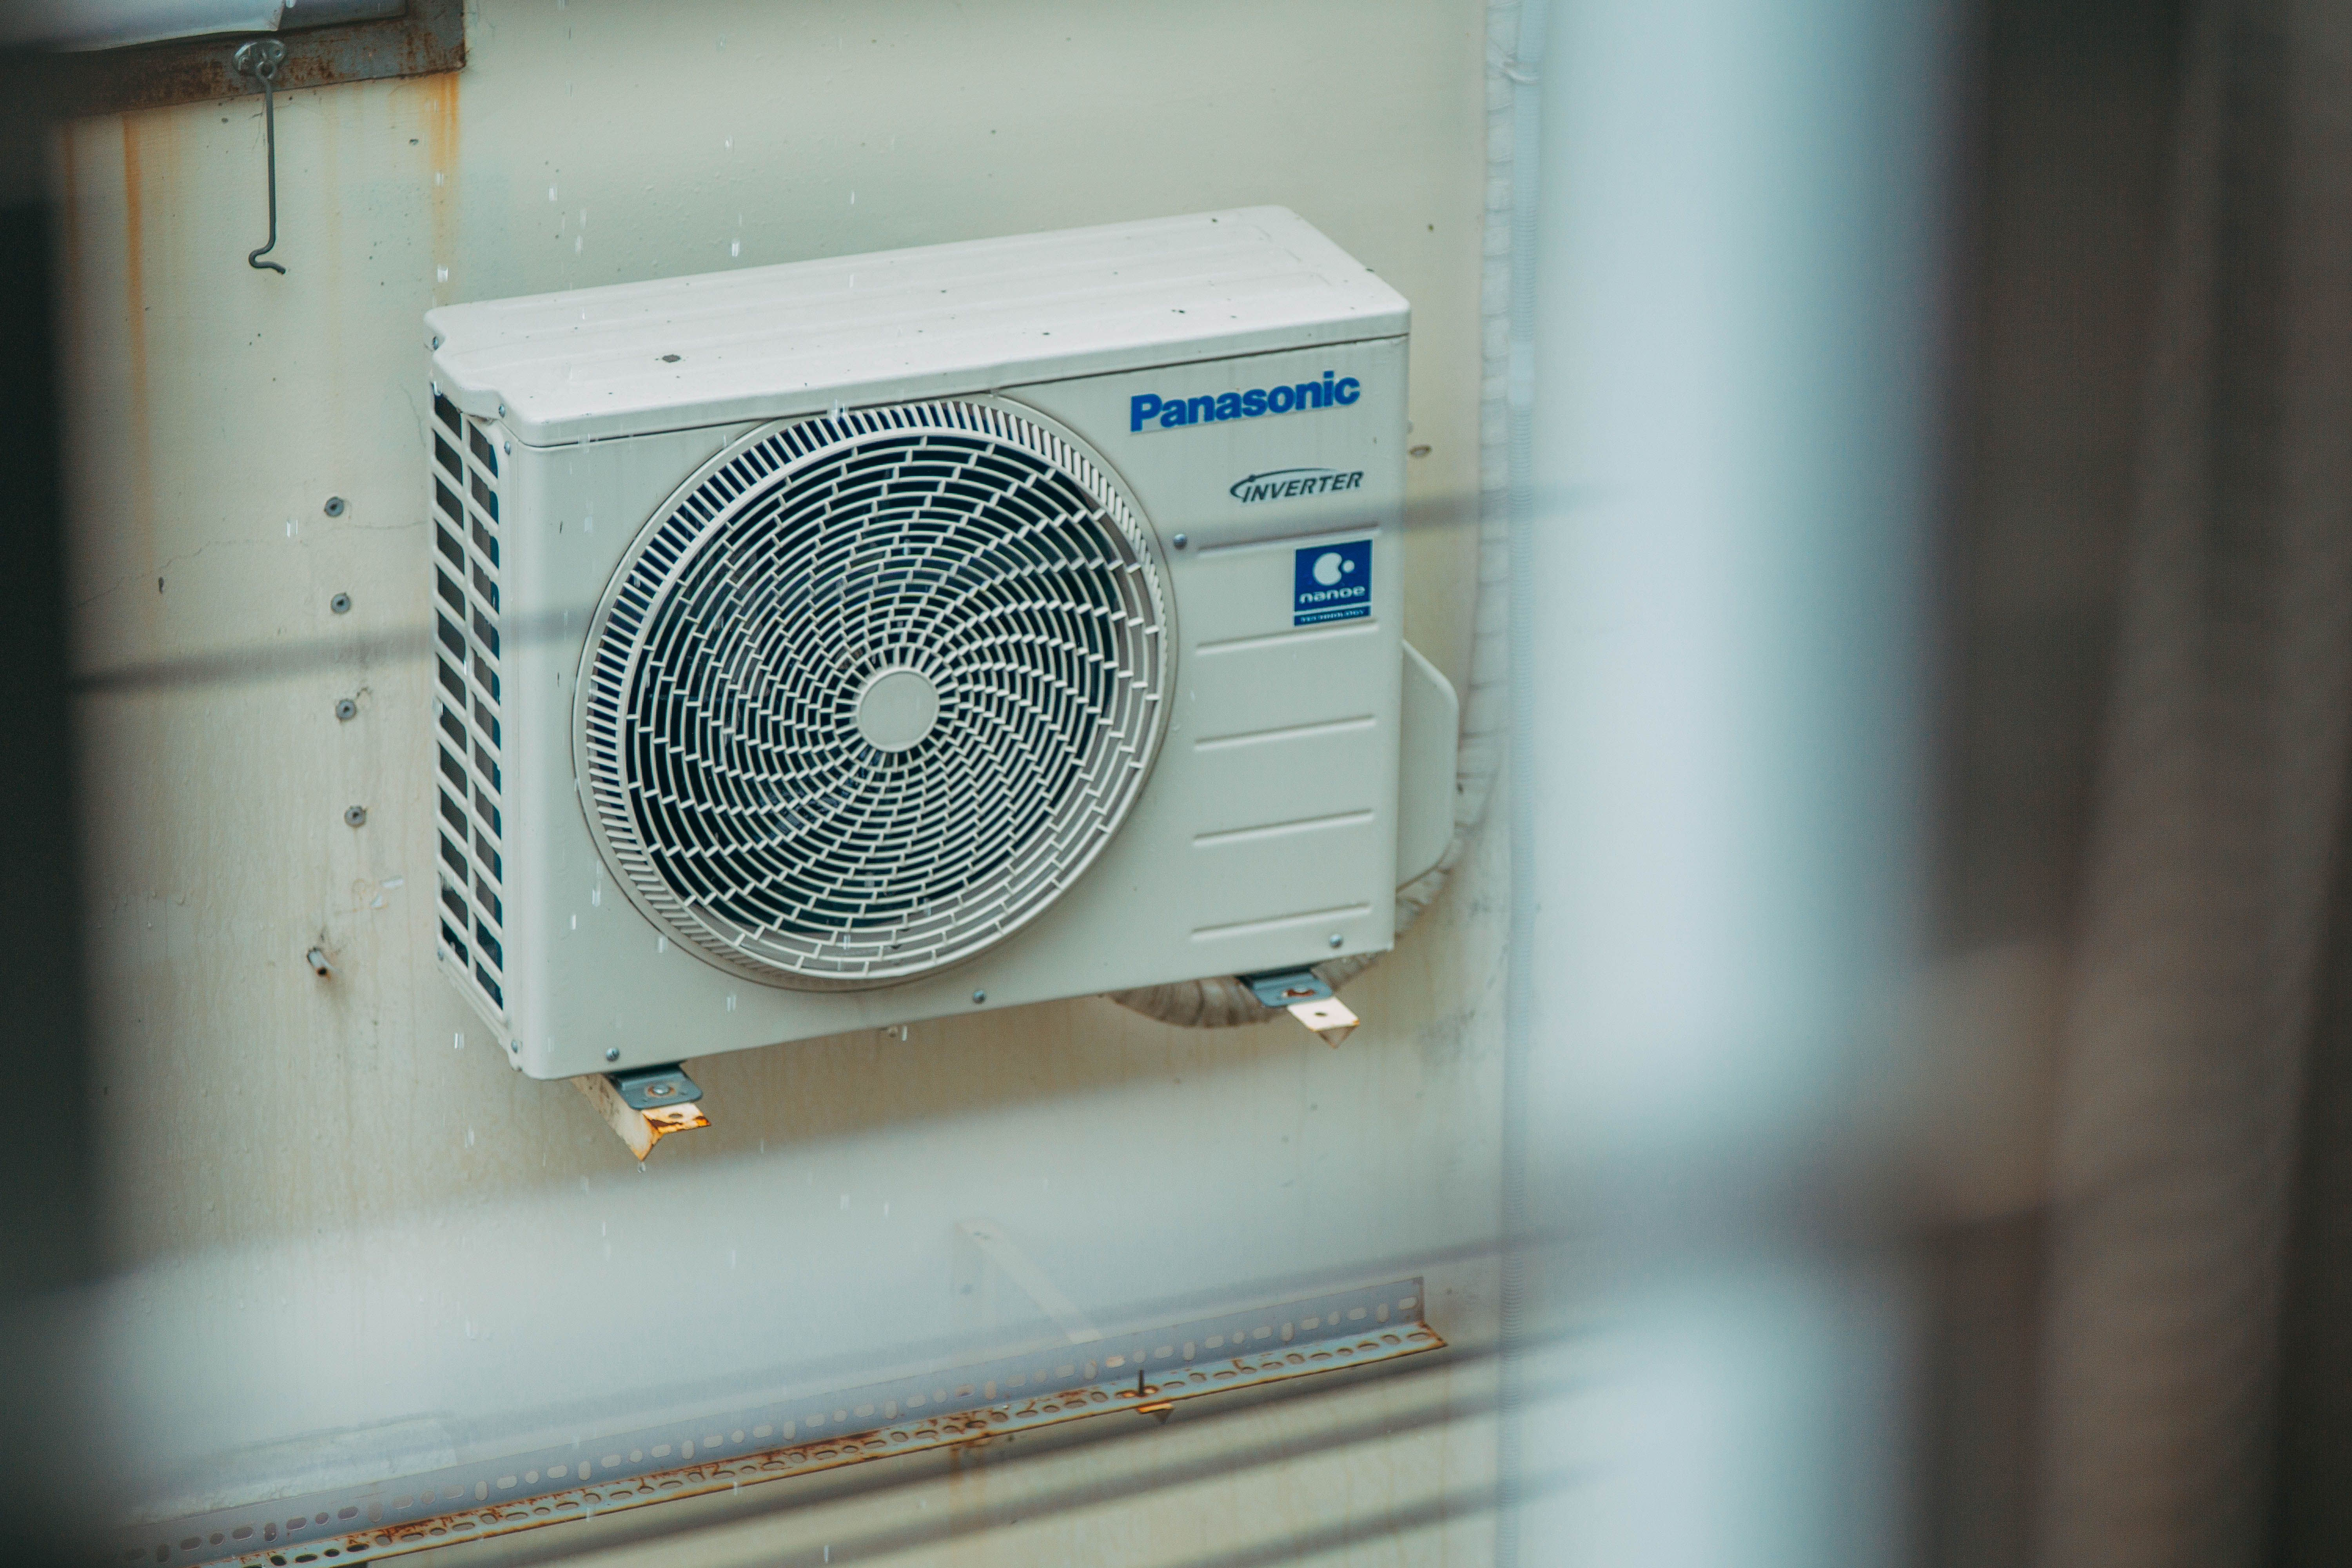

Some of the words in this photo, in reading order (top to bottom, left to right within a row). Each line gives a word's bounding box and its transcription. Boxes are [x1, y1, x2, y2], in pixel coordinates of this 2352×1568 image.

[1131, 370, 1360, 432] Panasonic
[1241, 471, 1363, 503] INVERTER
[1299, 586, 1365, 604] nanoe
